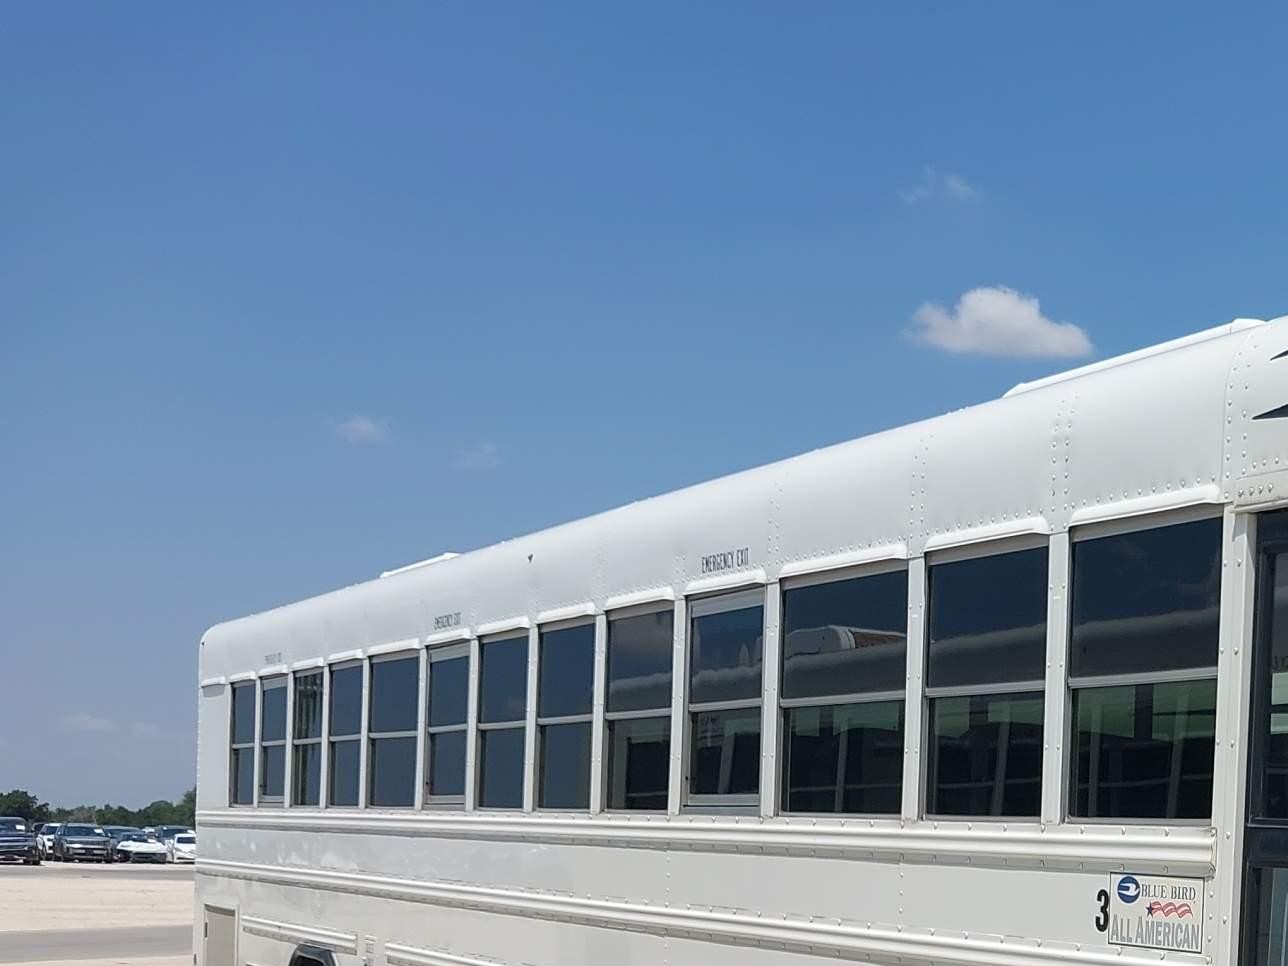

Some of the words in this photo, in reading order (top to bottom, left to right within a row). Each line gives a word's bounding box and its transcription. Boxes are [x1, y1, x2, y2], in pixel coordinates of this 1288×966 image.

[701, 551, 735, 574] EMERGENCY
[736, 547, 749, 568] EXIT
[1141, 883, 1167, 899] BLUE
[1170, 885, 1196, 901] BIRD
[1095, 889, 1110, 932] 3
[1110, 914, 1132, 943] ALL
[1135, 916, 1199, 950] AMERICAN
